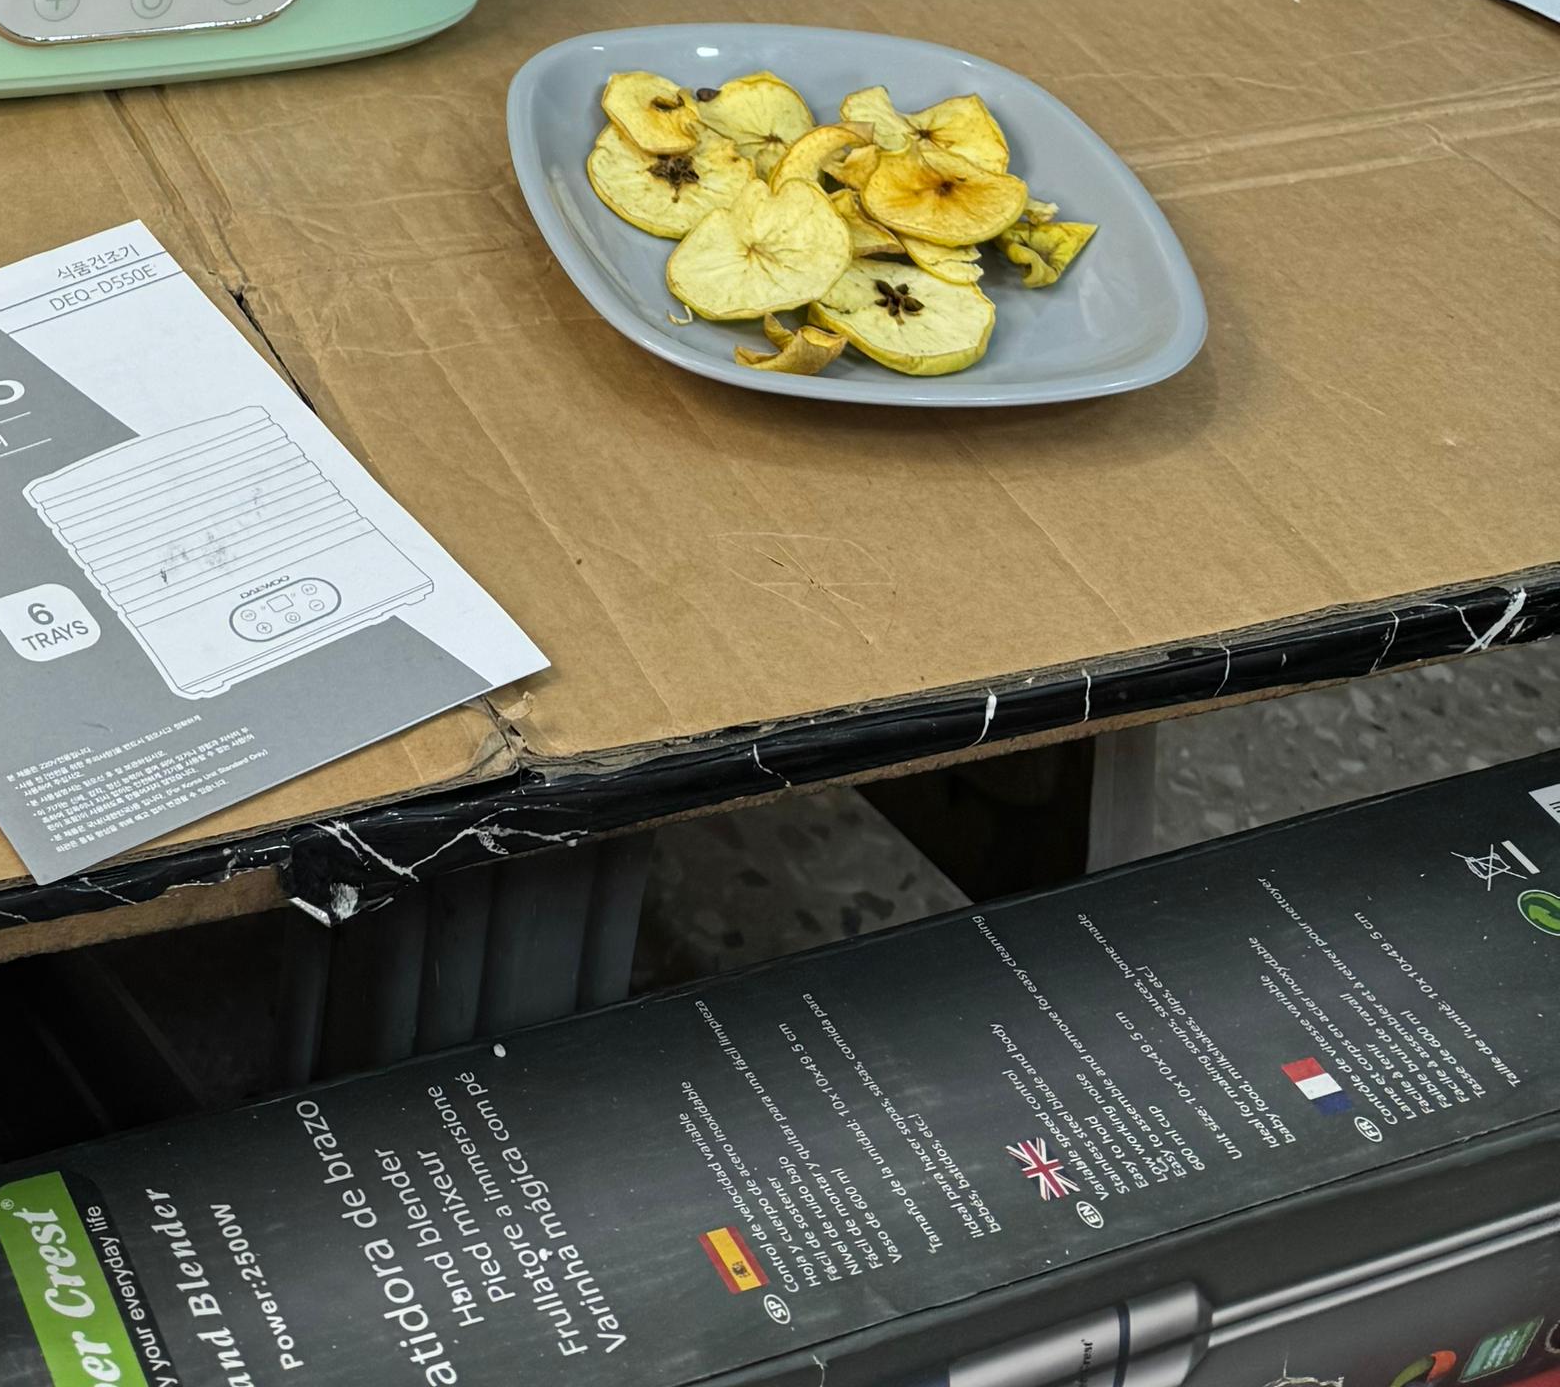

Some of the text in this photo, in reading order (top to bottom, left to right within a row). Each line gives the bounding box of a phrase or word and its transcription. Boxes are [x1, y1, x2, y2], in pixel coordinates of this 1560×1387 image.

[49, 262, 158, 314] DEQ-D550E
[55, 242, 142, 283] 식품건조기
[21, 616, 91, 655] TRAYS
[28, 602, 55, 628] 6
[239, 575, 291, 600] DAEWOO
[972, 915, 1187, 1176] Easy to assemble and remove for easy cleanning
[1365, 1043, 1394, 1069] tenir
[1400, 1080, 1434, 1113] Facile
[990, 1024, 1130, 1193] Stainless steel blade and body
[1001, 1069, 1109, 1200] Variable speed control
[1076, 1073, 1168, 1182] Low working noise
[1084, 1115, 1149, 1188] Easy to hold
[1148, 1105, 1205, 1170] 600 ml cup
[296, 1100, 376, 1227] de brazo
[454, 1071, 627, 1353] Varinha mágica com pé
[830, 1167, 902, 1263] Vaso de 600 ml
[19, 1208, 94, 1317] Crest
[145, 1188, 221, 1316] Blender
[374, 1149, 484, 1326] Hand blender
[416, 1150, 515, 1302] Pied mixeur
[427, 1085, 588, 1356] Frullatore a immersione
[767, 1177, 842, 1281] Fácil de sostener
[86, 1205, 170, 1370] your everyday life
[210, 1204, 303, 1369] Power:2500W
